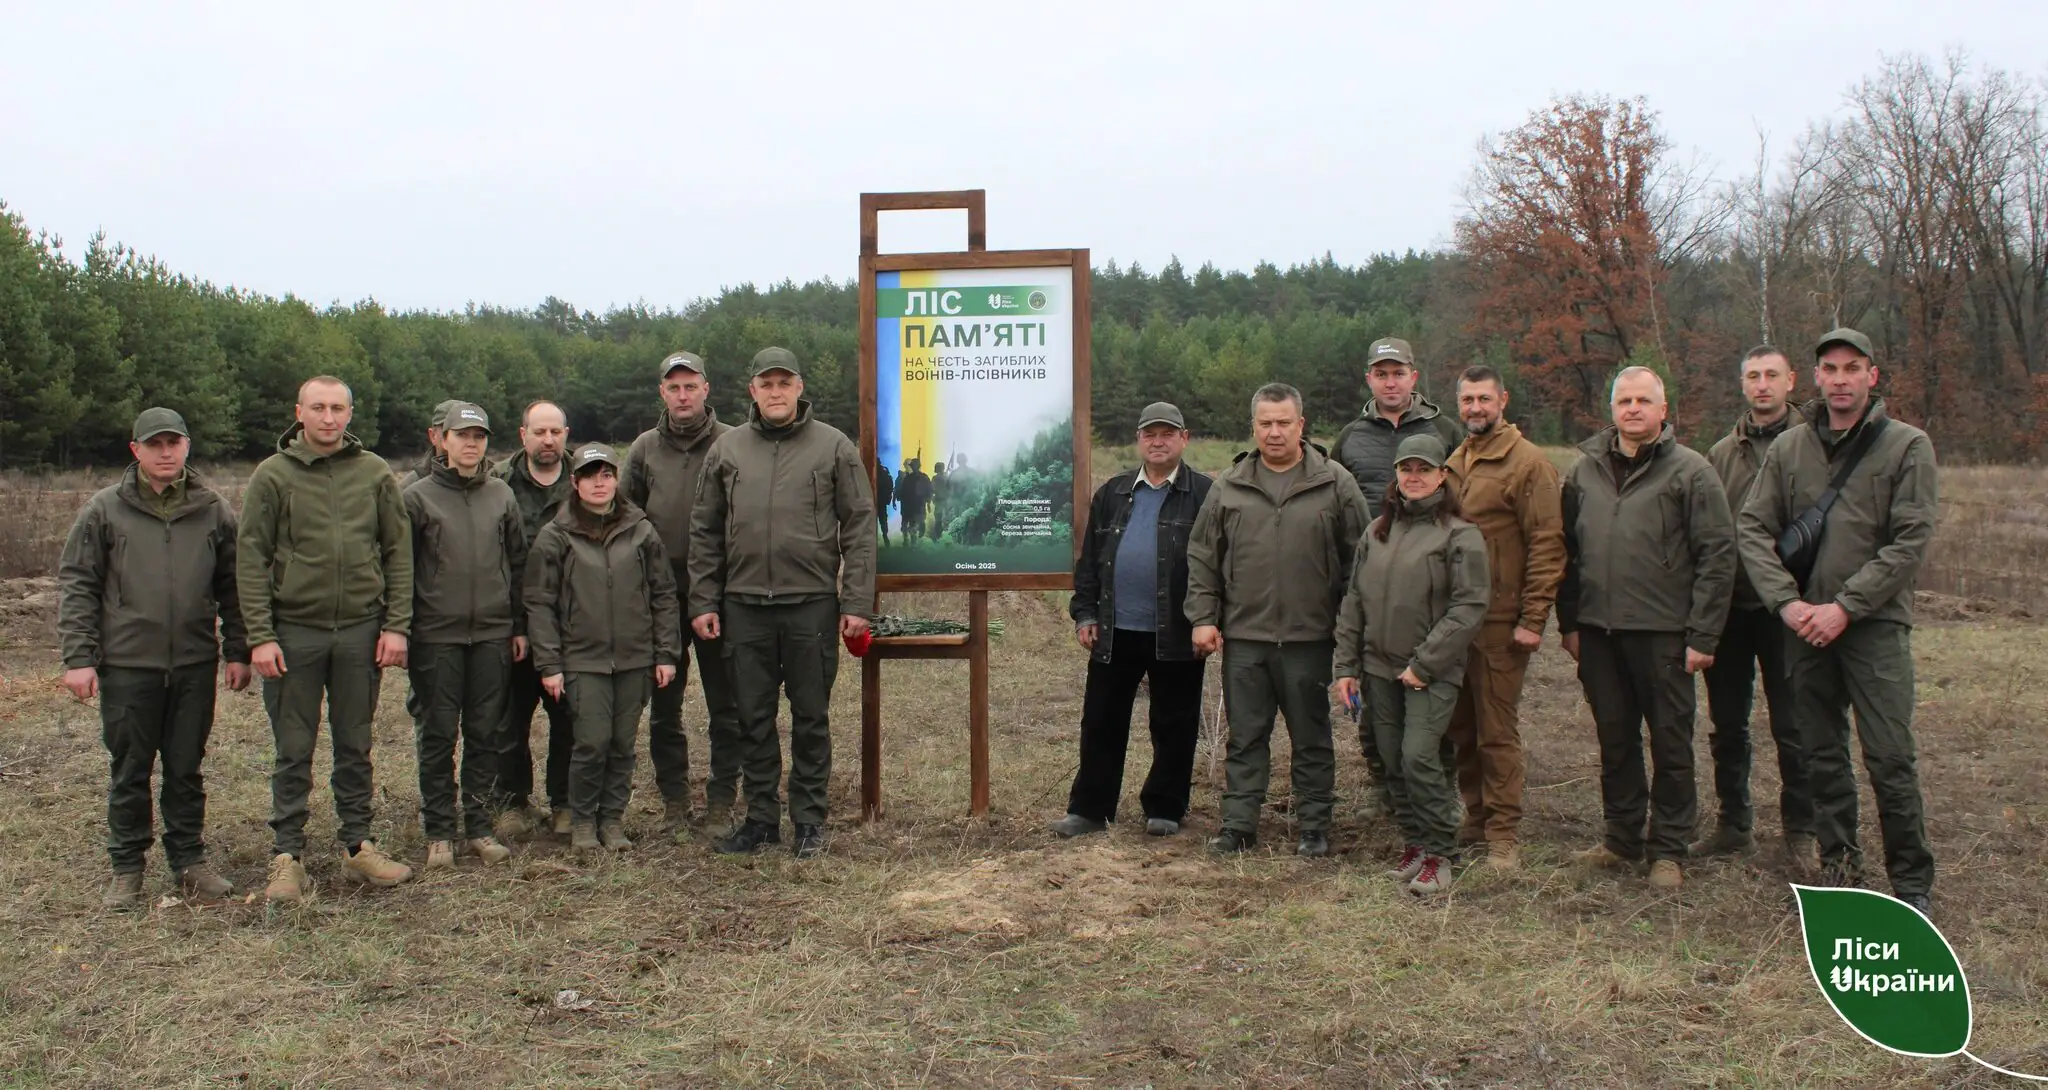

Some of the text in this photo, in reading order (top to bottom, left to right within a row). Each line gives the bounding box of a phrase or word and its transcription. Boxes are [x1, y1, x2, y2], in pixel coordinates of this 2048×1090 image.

[904, 290, 963, 316] ЛІС
[905, 323, 1046, 348] ПАМ’ЯТІ
[905, 355, 1046, 367] НА ЧЕСТЬ ЗАГИБЛИХ
[905, 367, 1046, 381] ВОЇНІВ-ЛІСІВНИКІВ
